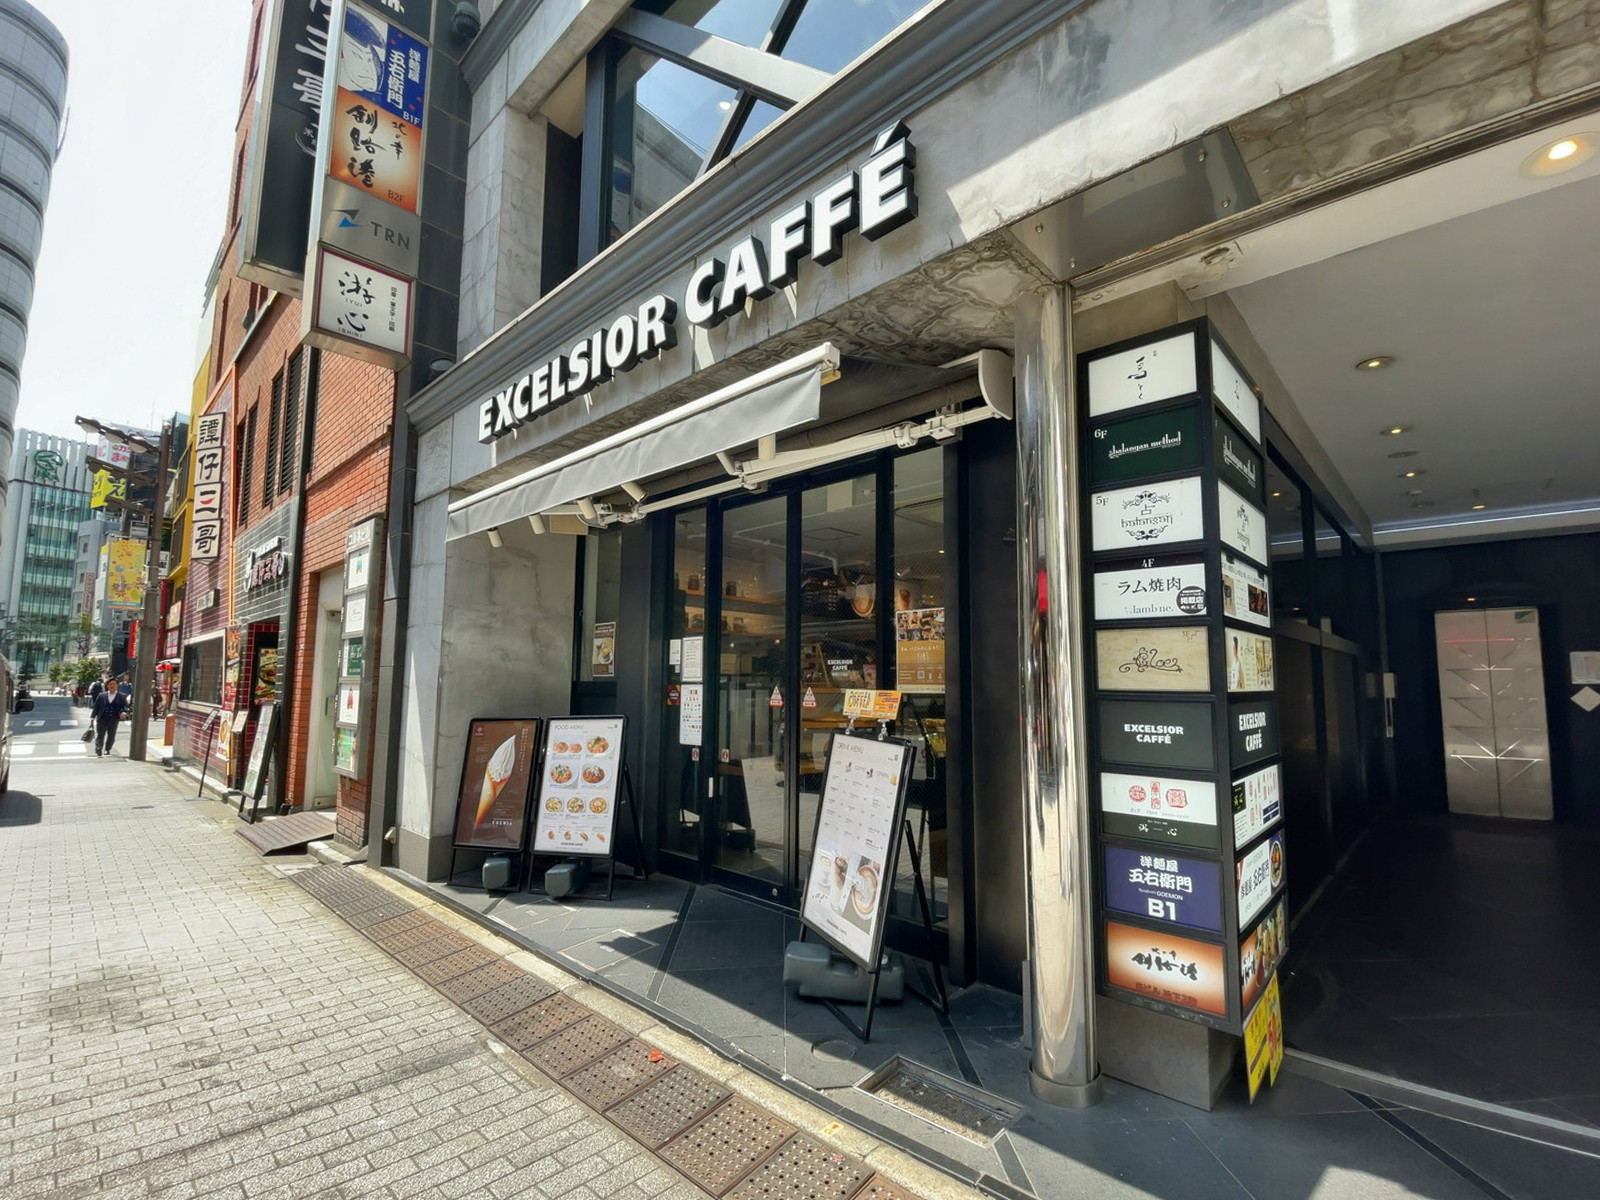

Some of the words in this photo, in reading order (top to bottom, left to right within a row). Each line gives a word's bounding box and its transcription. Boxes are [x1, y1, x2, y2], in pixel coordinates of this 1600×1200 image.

[387, 49, 406, 110] 五右衛門
[402, 110, 421, 126] B1F
[387, 189, 405, 203] B2F
[370, 221, 410, 251] TRN
[478, 293, 677, 443] EXCELSIOR
[685, 119, 917, 329] CAFFÉ
[1094, 428, 1108, 439] 6F
[1151, 431, 1181, 449] method
[194, 418, 220, 554] 譚仔三哥
[1096, 495, 1109, 506] 5F
[1141, 558, 1155, 568] 4F
[1117, 576, 1182, 596] ラム焼肉
[1124, 723, 1184, 735] EXCELSIOR
[1239, 712, 1266, 731] EXCELSIOR
[1136, 733, 1172, 744] CAFFÉ
[1246, 729, 1262, 752] CAFFÉ
[1128, 868, 1193, 893] 五右衛門
[1156, 890, 1184, 901] GOEMON
[1147, 897, 1176, 921] B1
